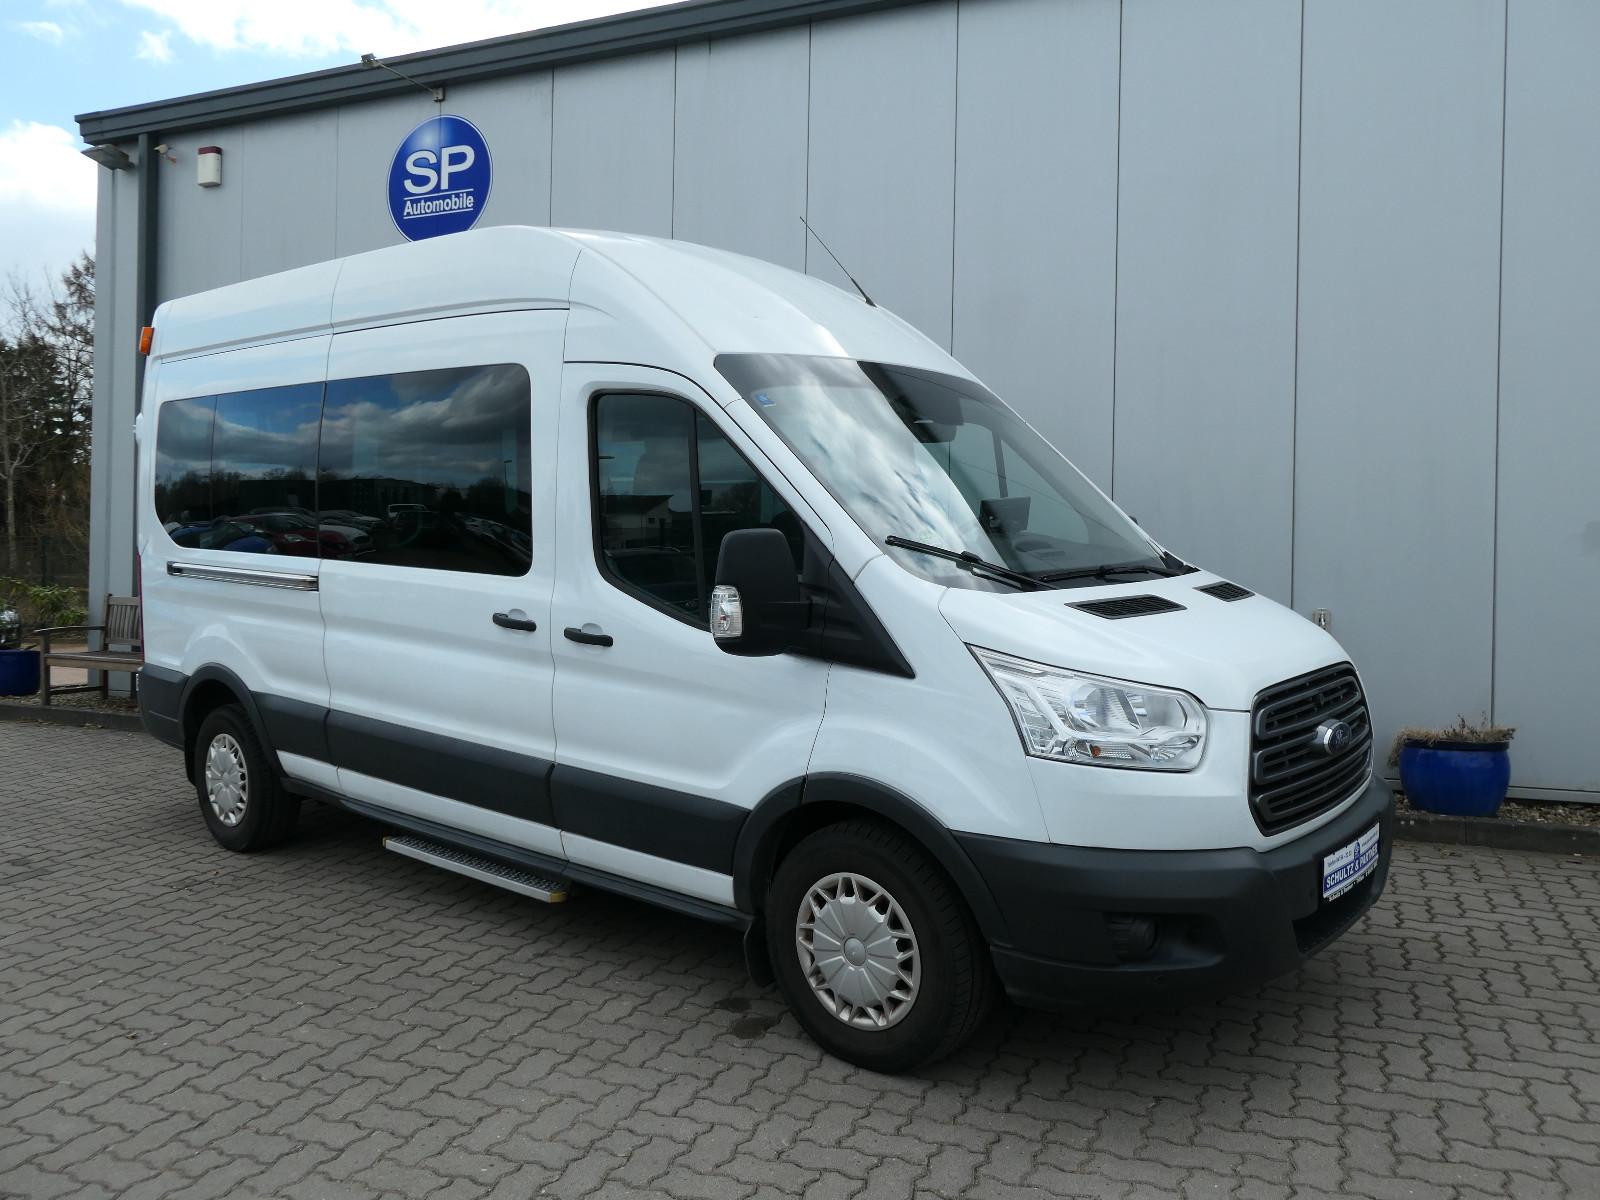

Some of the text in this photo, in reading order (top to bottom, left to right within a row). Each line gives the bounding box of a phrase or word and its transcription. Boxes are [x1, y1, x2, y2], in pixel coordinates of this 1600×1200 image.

[404, 145, 475, 194] SP
[403, 193, 474, 216] Automobile
[1326, 864, 1354, 889] SCHULTZ
